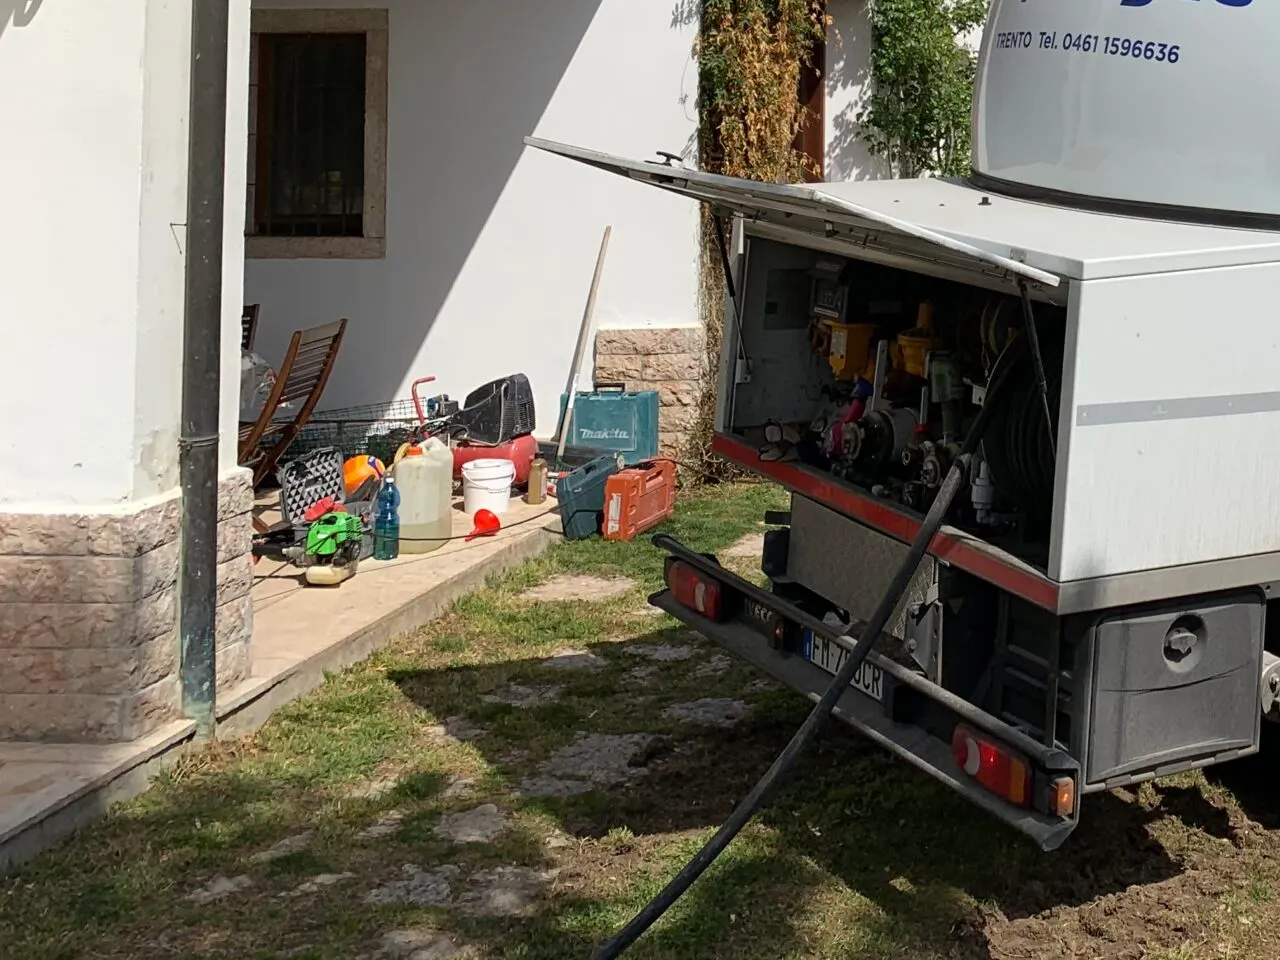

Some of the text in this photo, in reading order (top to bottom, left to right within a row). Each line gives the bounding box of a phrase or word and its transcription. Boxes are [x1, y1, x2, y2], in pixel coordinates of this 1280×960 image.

[996, 31, 1180, 64] TRENTO Tel. 0461 1596636
